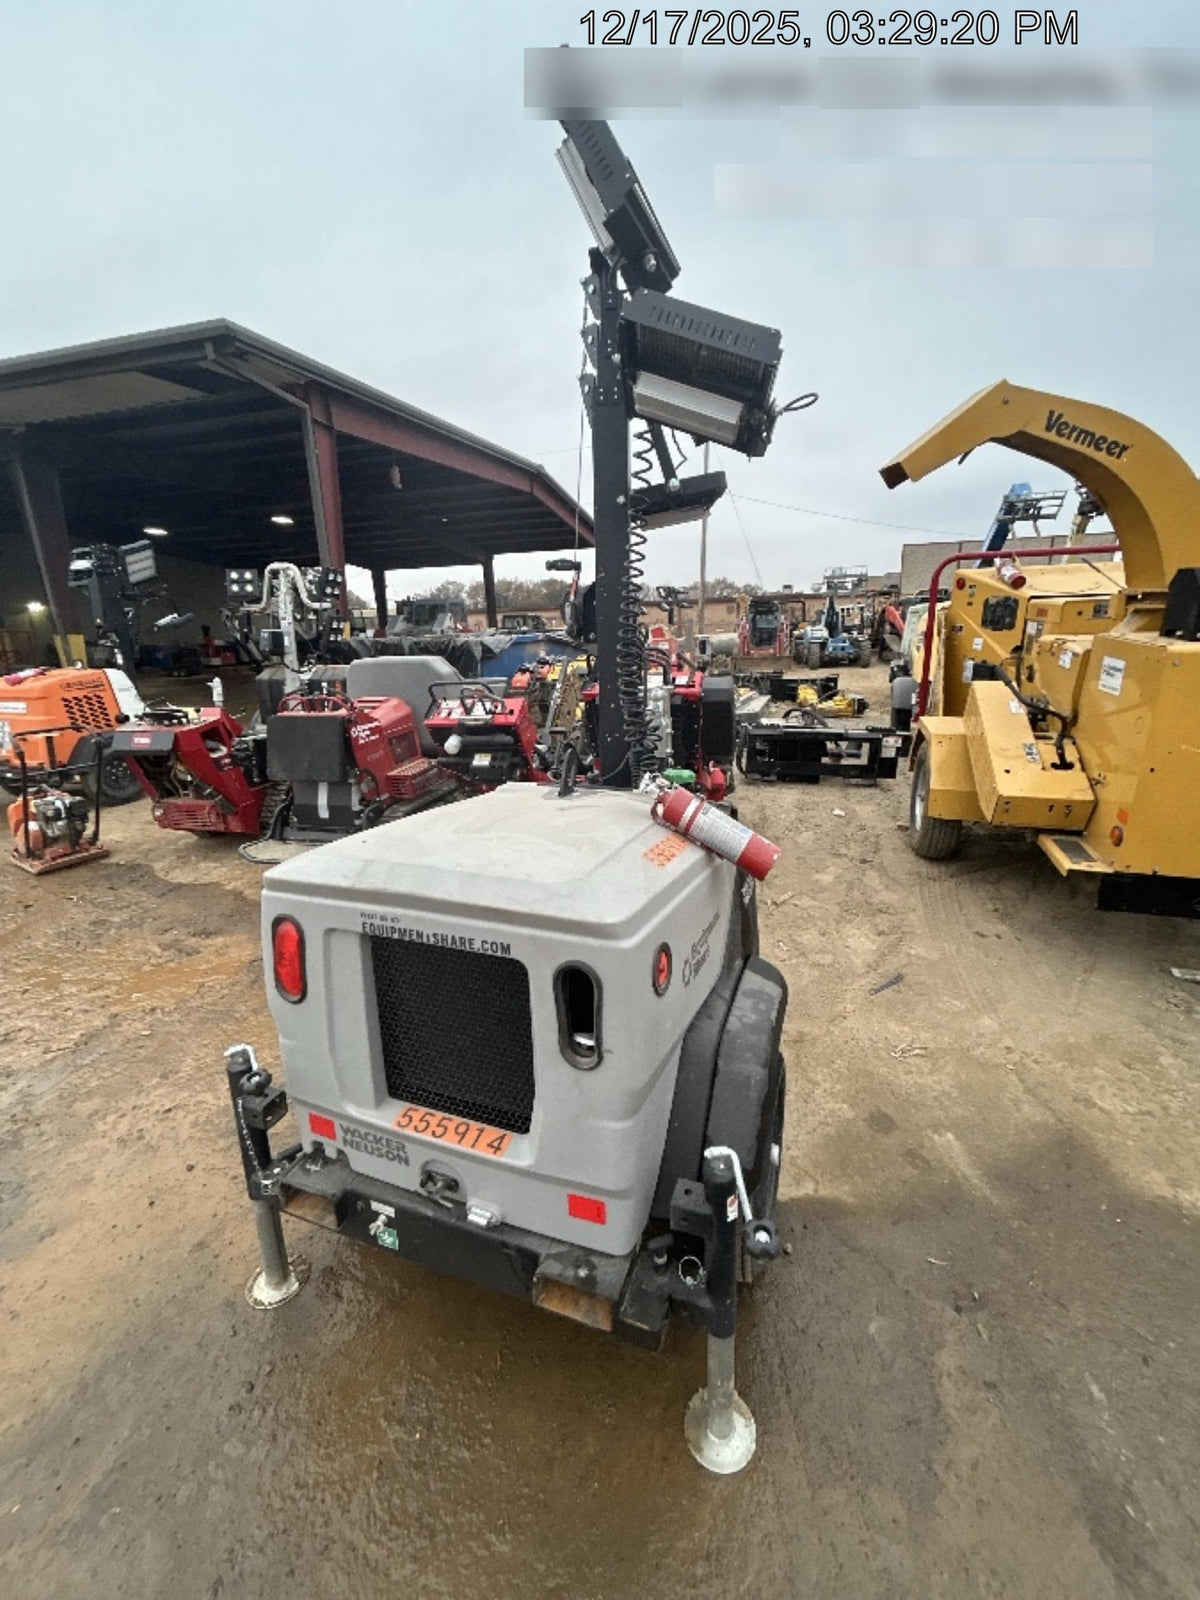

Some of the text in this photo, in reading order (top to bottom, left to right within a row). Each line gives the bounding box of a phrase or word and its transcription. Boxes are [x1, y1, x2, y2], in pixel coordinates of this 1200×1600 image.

[1045, 409, 1129, 459] Vermeer
[339, 1123, 407, 1155] WACKER
[396, 1106, 507, 1155] 555914
[343, 1137, 410, 1167] NEUSON
